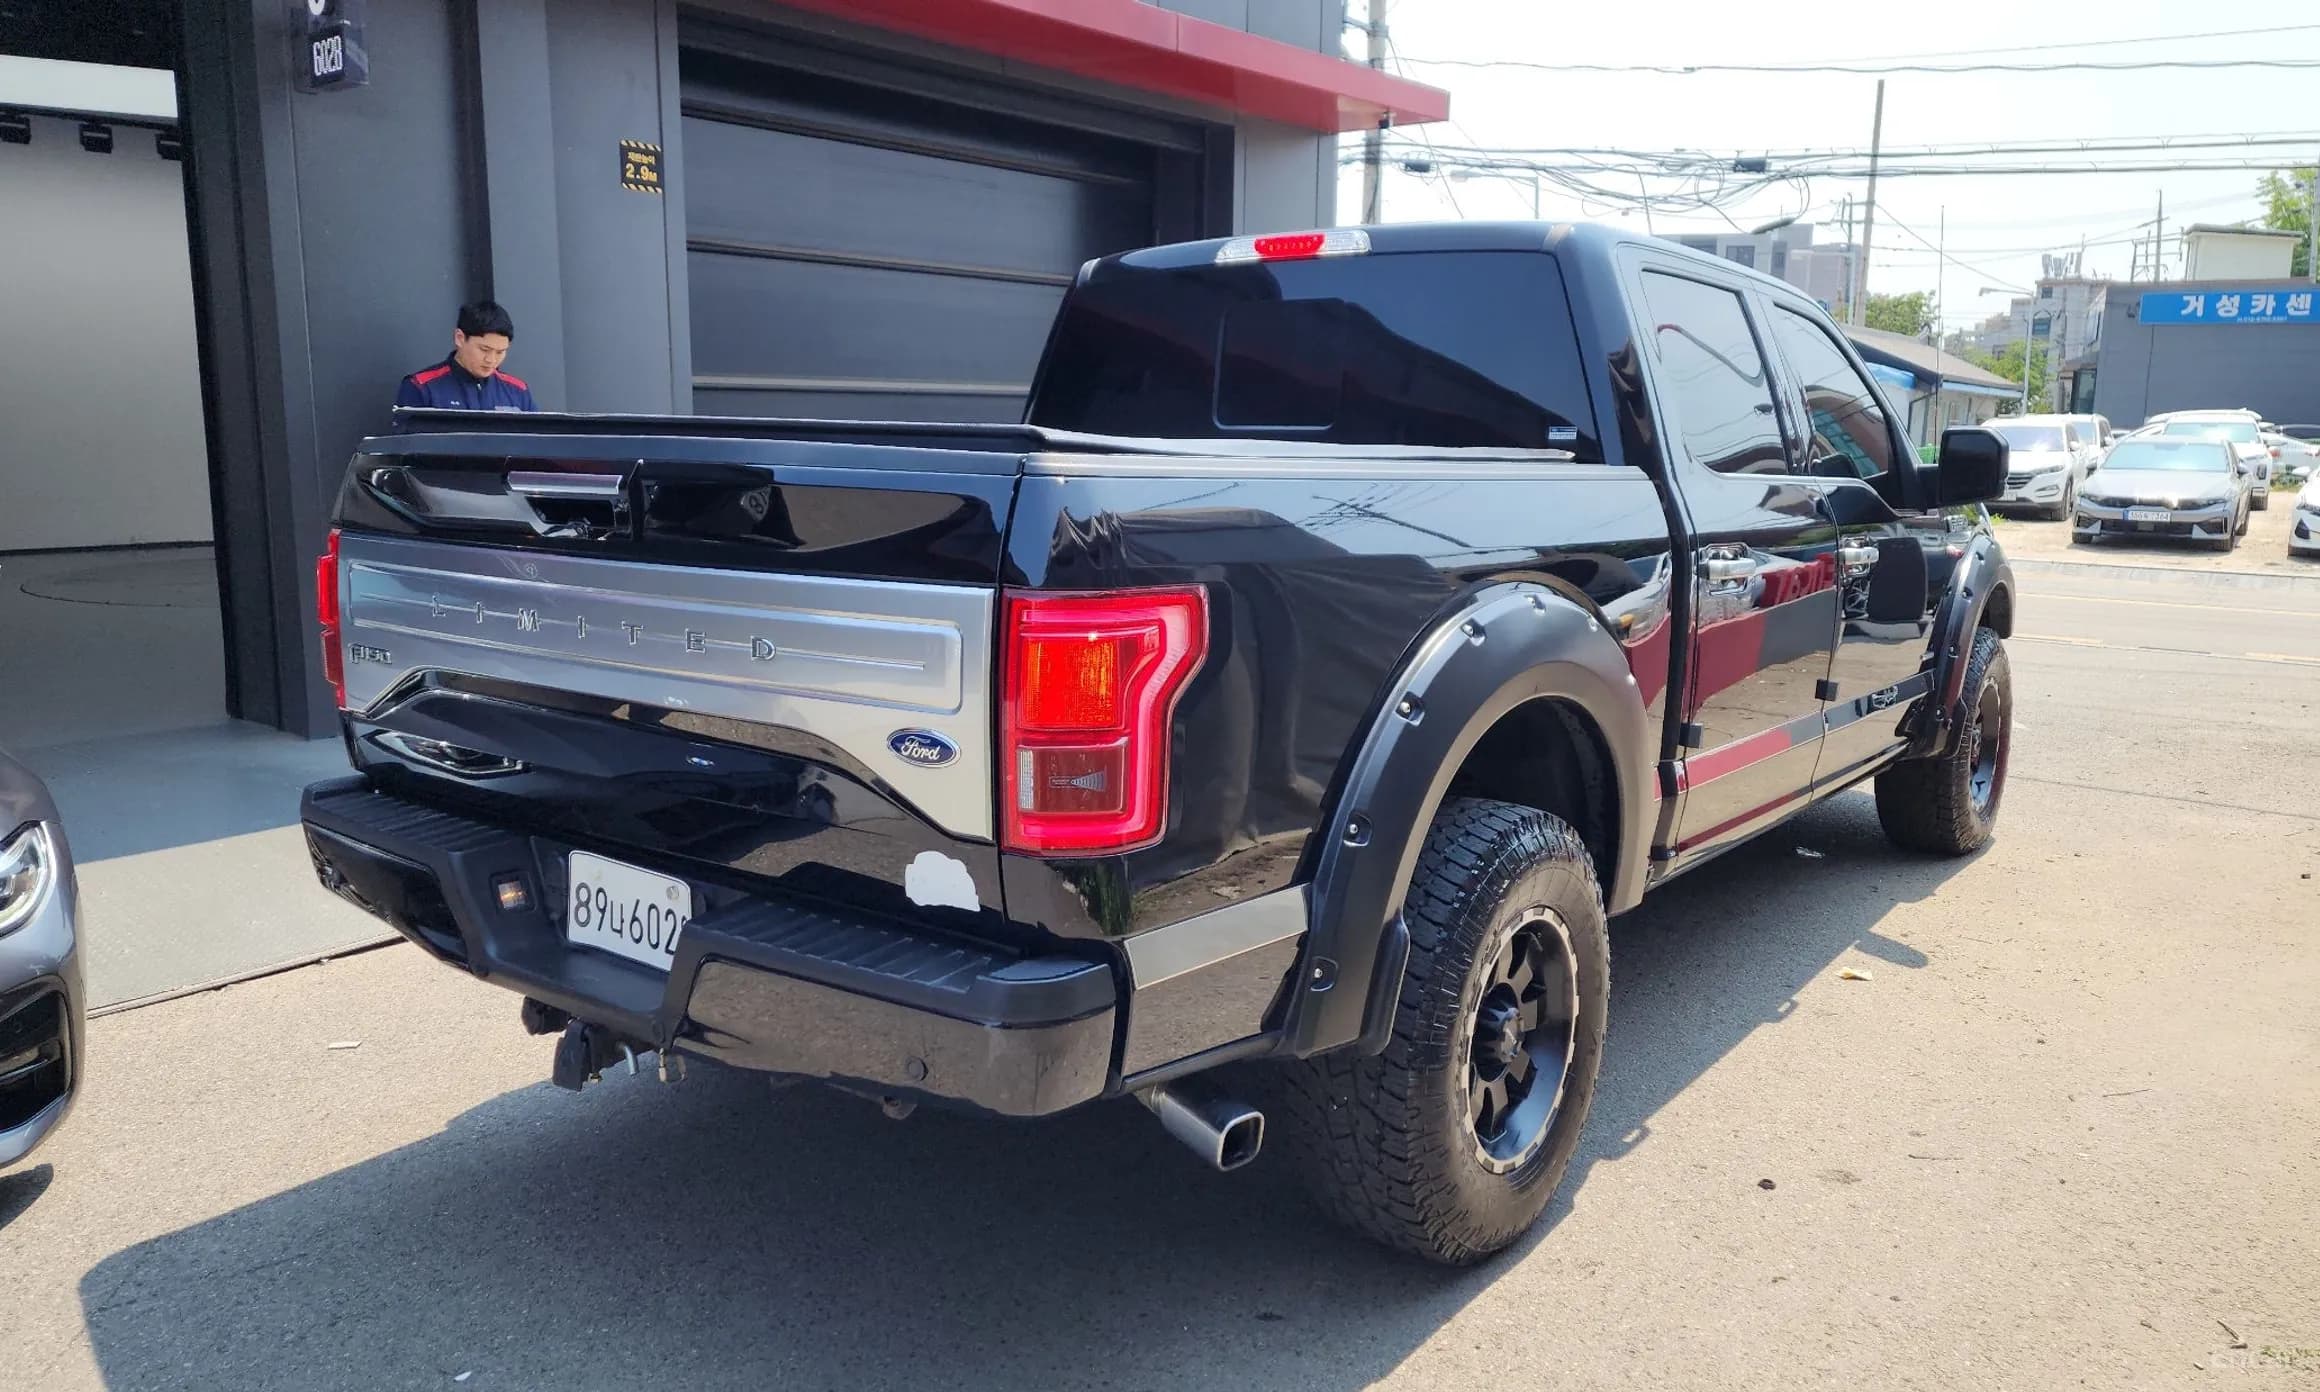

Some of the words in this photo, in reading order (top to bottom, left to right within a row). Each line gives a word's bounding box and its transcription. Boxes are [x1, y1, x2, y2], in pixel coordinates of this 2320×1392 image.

[432, 592, 777, 662] LIMITED
[901, 735, 941, 760] Ford
[574, 881, 688, 956] 89나602
